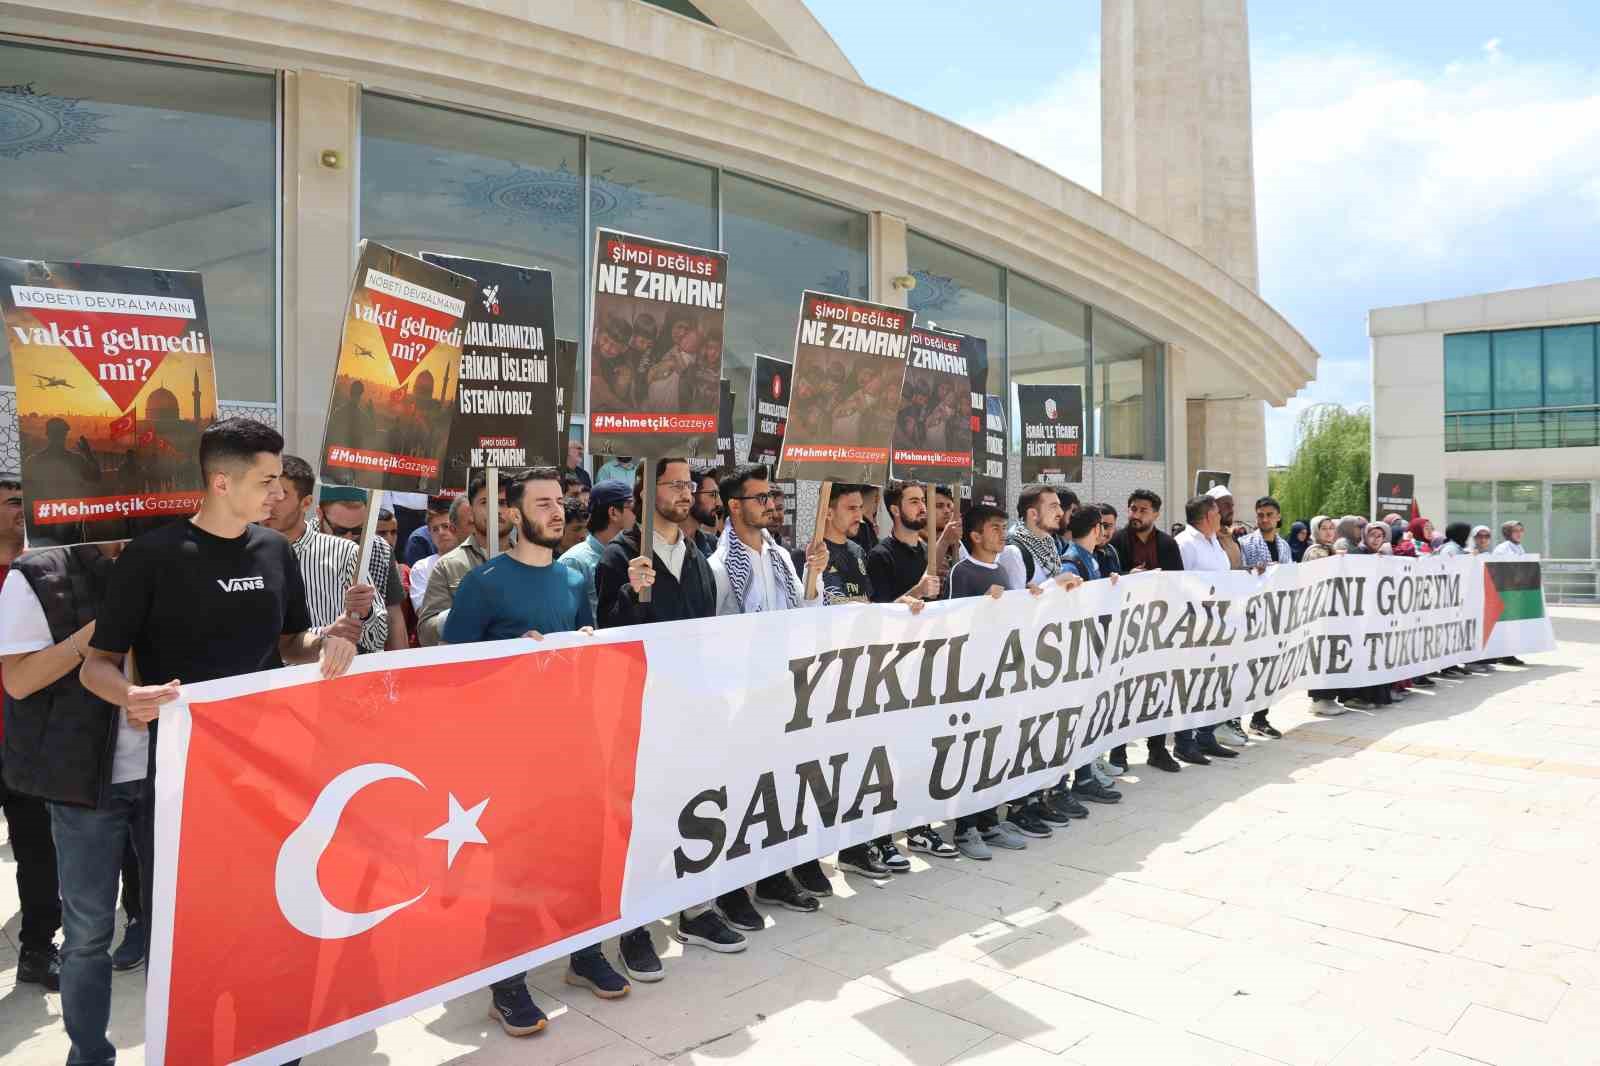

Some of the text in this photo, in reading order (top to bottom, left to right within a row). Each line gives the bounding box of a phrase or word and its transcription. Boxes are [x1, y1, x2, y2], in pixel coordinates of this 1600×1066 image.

[612, 246, 713, 276] ŞİMDİ DEĞİLSE
[599, 263, 723, 309] NE ZAMAN!
[85, 294, 192, 314] DEVRALMANIN
[815, 303, 900, 330] ŞİMDİ DEĞİLSE
[12, 322, 207, 356] vakti gelmedi
[354, 302, 463, 348] vakti gelmedi
[801, 319, 825, 346] NE
[829, 324, 908, 359] ZAMAN!
[392, 340, 426, 363] mi?
[912, 347, 968, 377] ZAMAN!
[98, 358, 152, 382] mi?
[501, 352, 548, 383] ÜSLERİNİ
[460, 384, 533, 415] İSTEMİYORUZ
[594, 414, 714, 432] #MehmetçikGazzeye
[329, 448, 438, 475] #MehmetçikGazzeye
[470, 448, 526, 467] NE ZAMAN!
[786, 447, 886, 461] #MehmetçikGazzeye
[894, 450, 970, 465] #MehmetçikGazzeye
[217, 576, 265, 593] VANS
[785, 614, 1112, 733] YIKILASIN
[1111, 584, 1236, 665] İSRAİL
[1243, 576, 1366, 643] ENKAZINI
[674, 612, 1477, 879] SANA ÜLKE DİYENİN YÜZÜNE TÜKÜREYİM!
